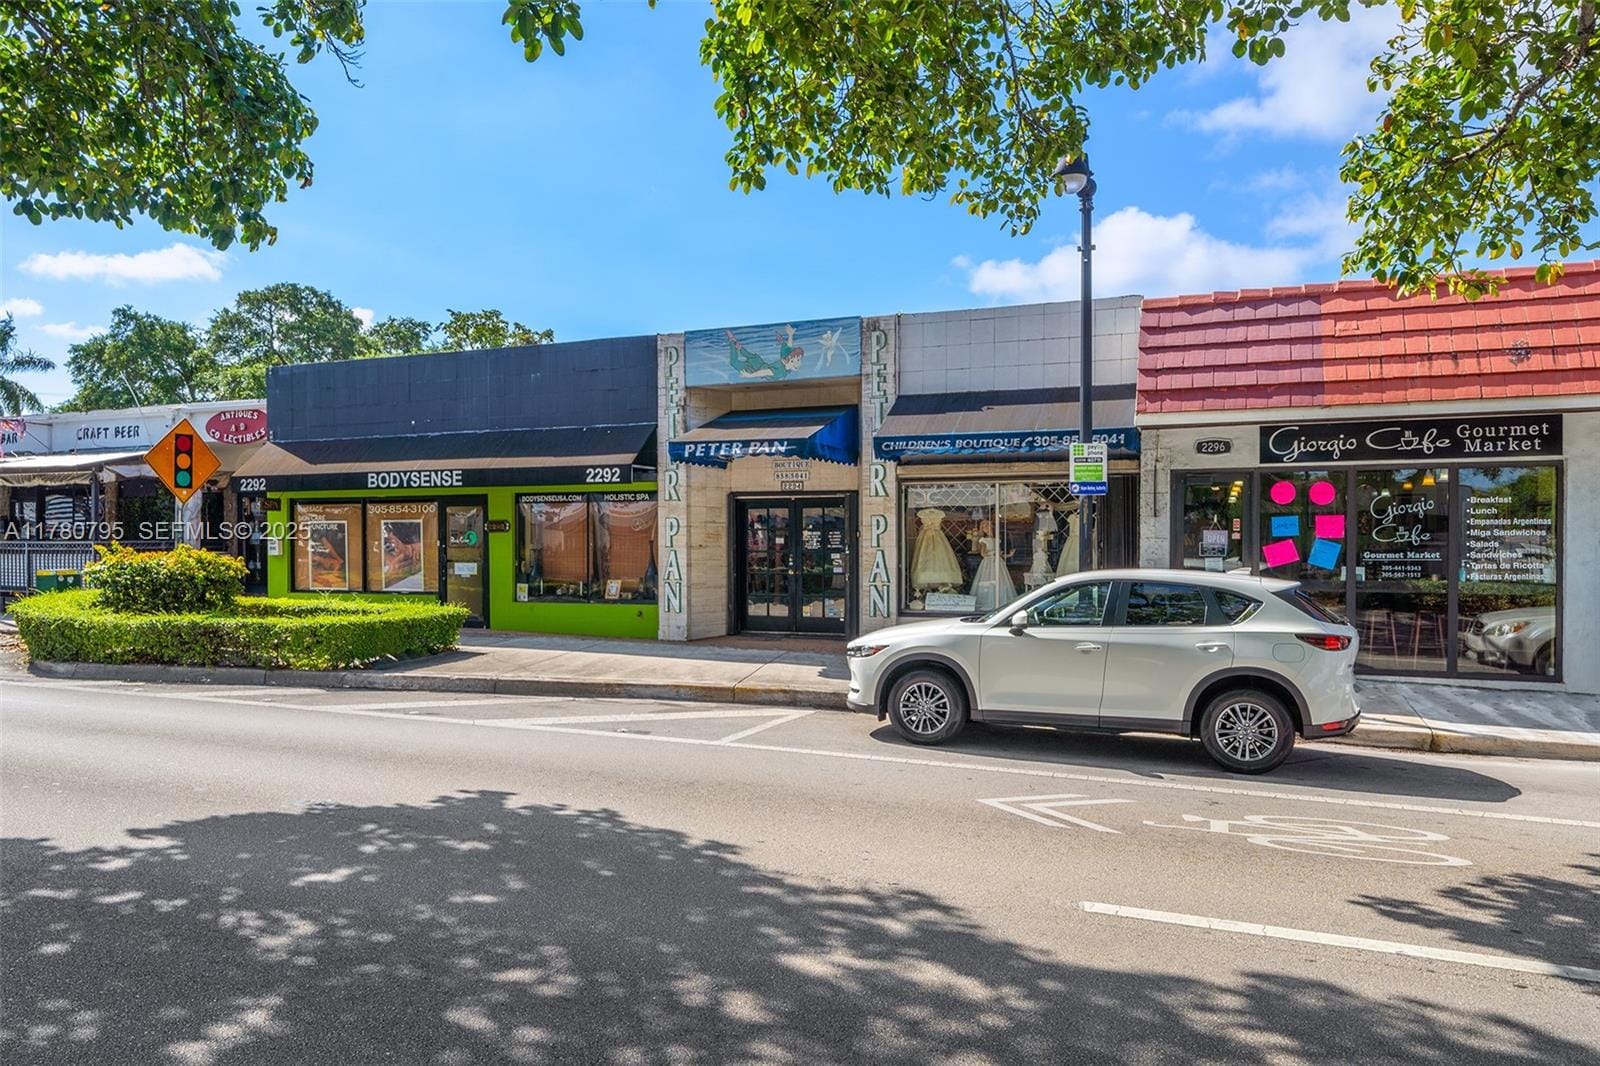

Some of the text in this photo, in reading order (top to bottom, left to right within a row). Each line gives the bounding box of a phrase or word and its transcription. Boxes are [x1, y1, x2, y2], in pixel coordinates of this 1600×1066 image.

[220, 410, 259, 421] ANTIQUES
[869, 330, 888, 497] PETR
[76, 425, 140, 441] CRAFT BEER
[1456, 422, 1550, 438] Gourmet
[684, 440, 789, 458] PETER PAN
[881, 433, 1126, 451] CHILDREN'S BOUTIQUE 305-855041
[1201, 442, 1226, 452] 2296
[1269, 426, 1358, 463] Giorgio
[1463, 438, 1542, 453] Market
[367, 471, 463, 488] BODYSENSE
[585, 467, 621, 483] 2292
[663, 346, 681, 613] PETR PAN
[240, 478, 266, 491] 2292
[521, 494, 583, 502] BODYSENSEUSA.COM
[604, 493, 650, 501] HOLISTIC SPA
[1470, 496, 1512, 504] Breakfast
[368, 504, 436, 514] 305-854-3100
[1370, 495, 1435, 524] Giorgio
[1470, 518, 1552, 526] Empanadas Argentinas
[1470, 528, 1547, 537] Miga Sandwiches
[1470, 540, 1499, 548] Salads
[1363, 551, 1441, 559] Gourmet Market
[869, 514, 890, 618] PAN
[1503, 573, 1545, 581] Argentinas
